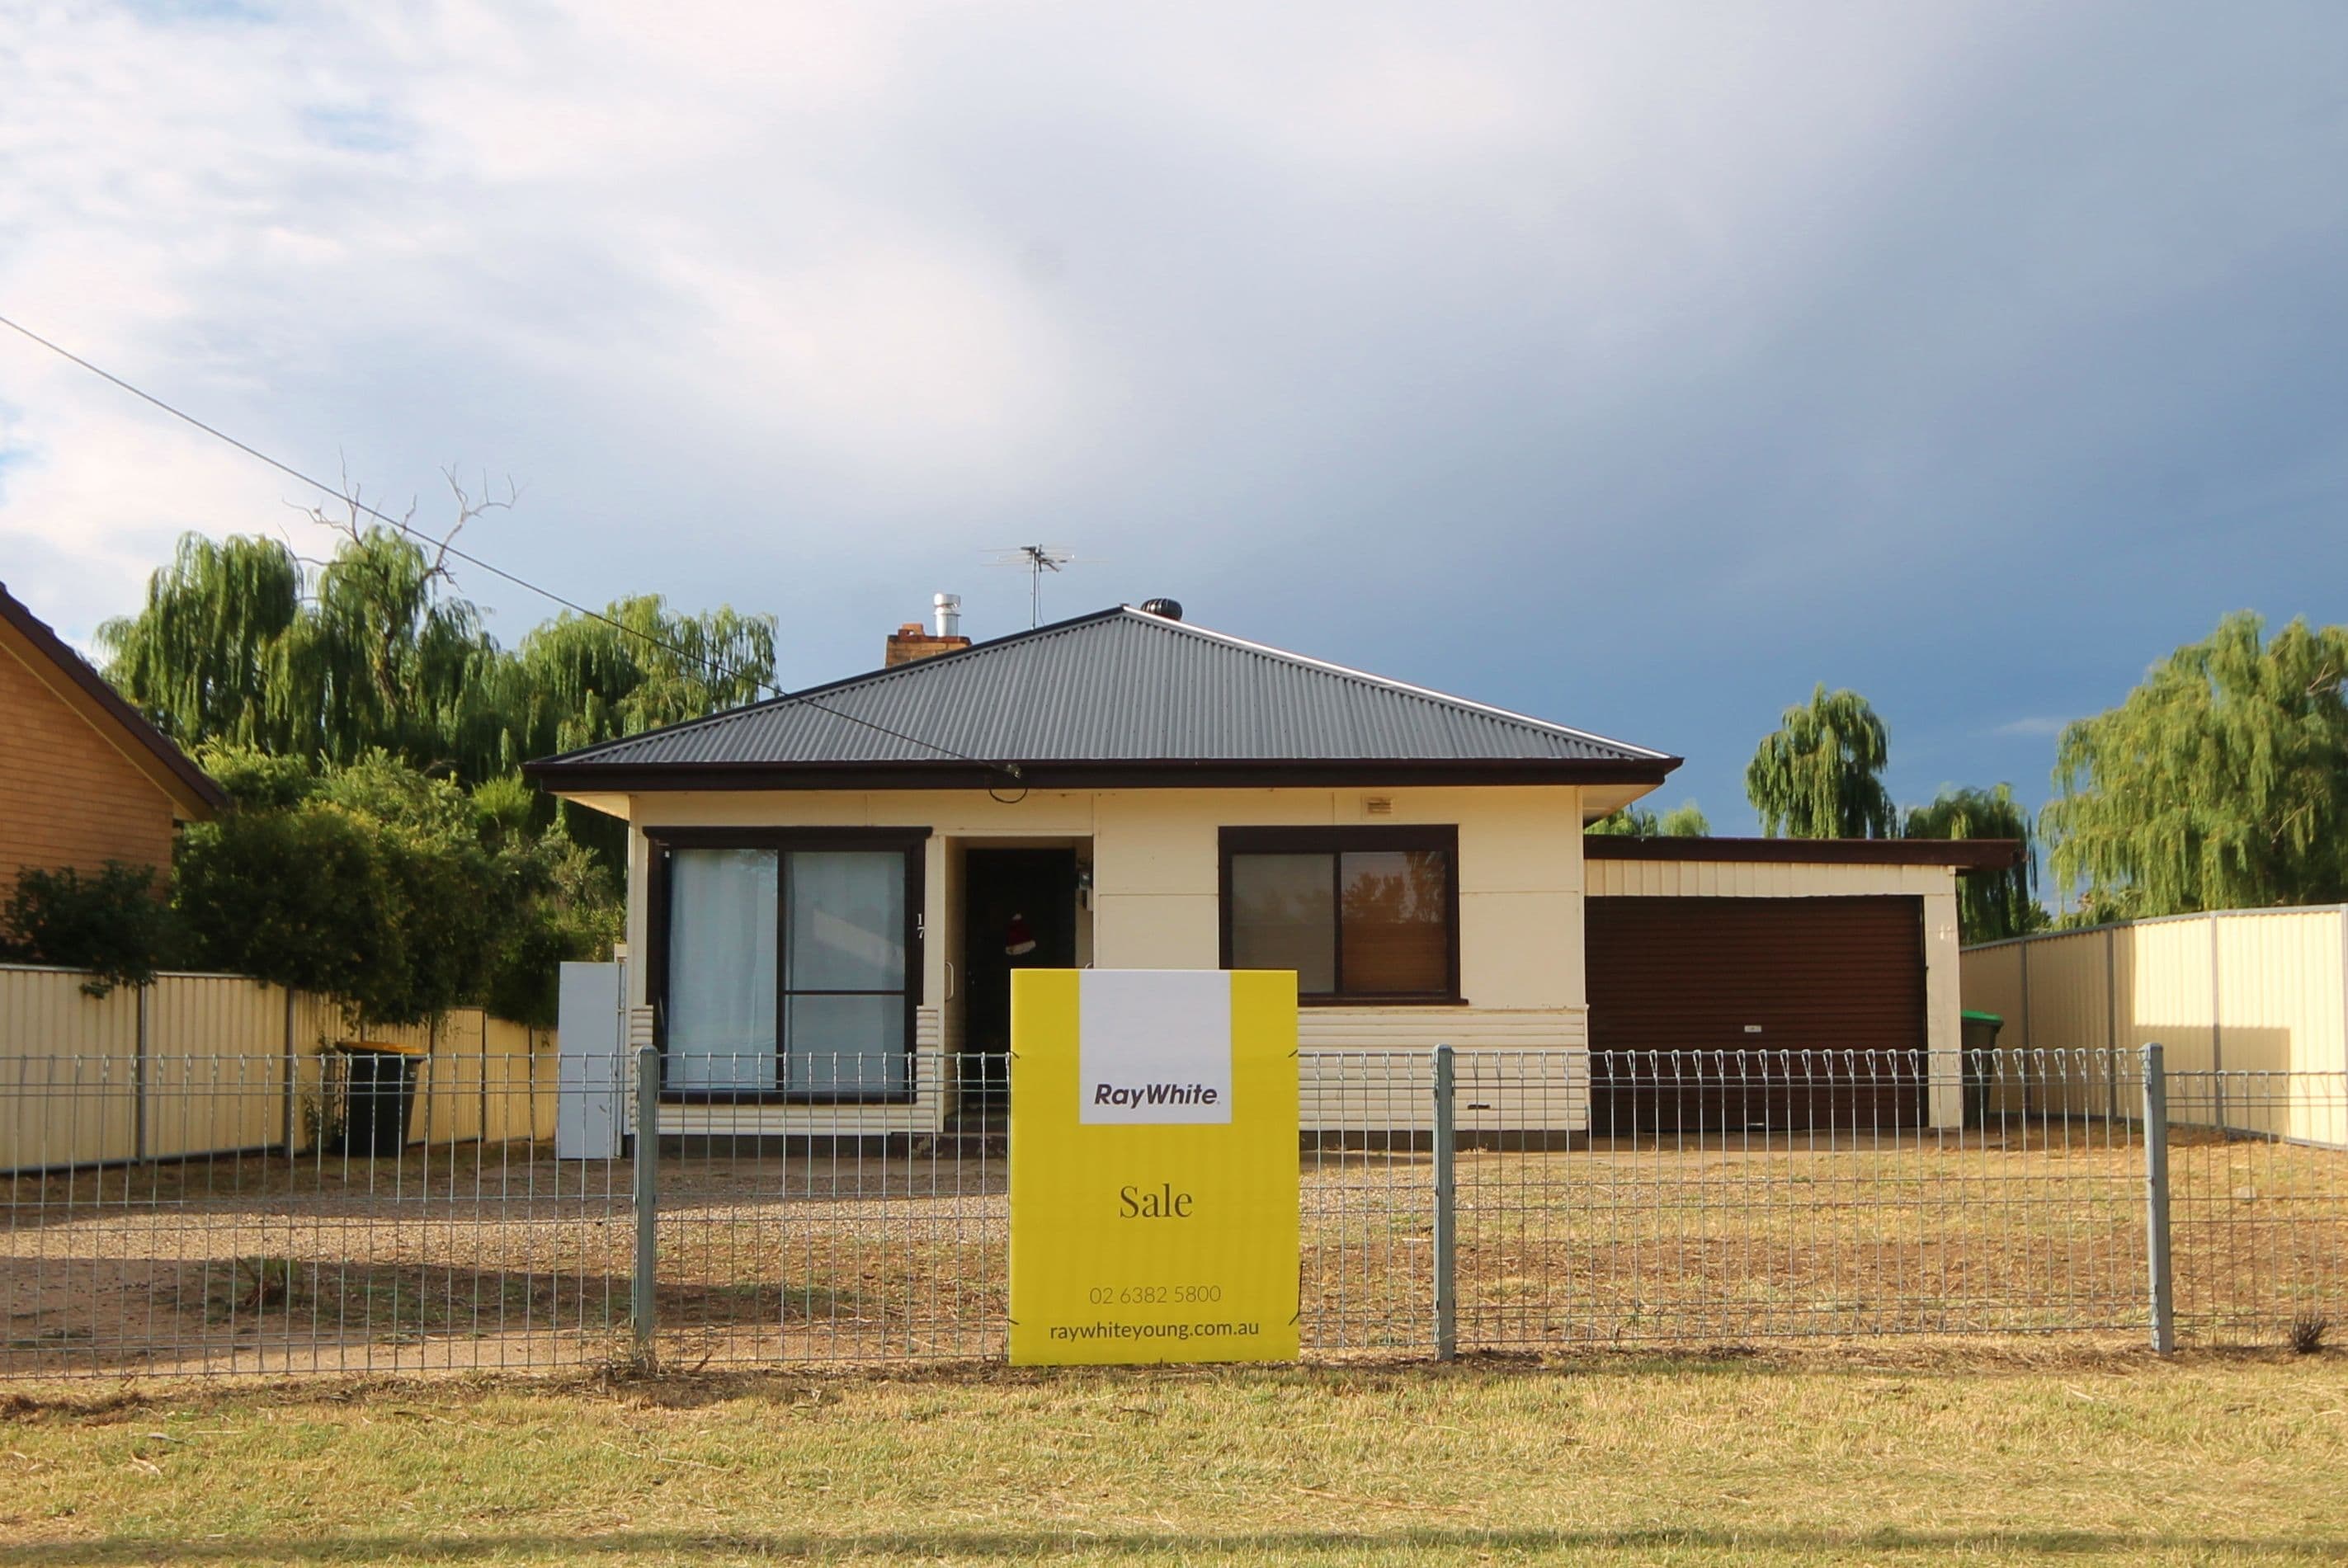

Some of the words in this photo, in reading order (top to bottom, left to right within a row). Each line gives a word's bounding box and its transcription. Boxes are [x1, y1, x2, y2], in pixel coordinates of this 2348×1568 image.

[1094, 1083, 1218, 1109] RayWhite
[1120, 1182, 1193, 1218] Sale
[1089, 1286, 1114, 1305] 02
[1120, 1286, 1167, 1304] 6382
[1174, 1285, 1222, 1303] 5800
[1049, 1321, 1260, 1343] raywhiteyoung.com.au
